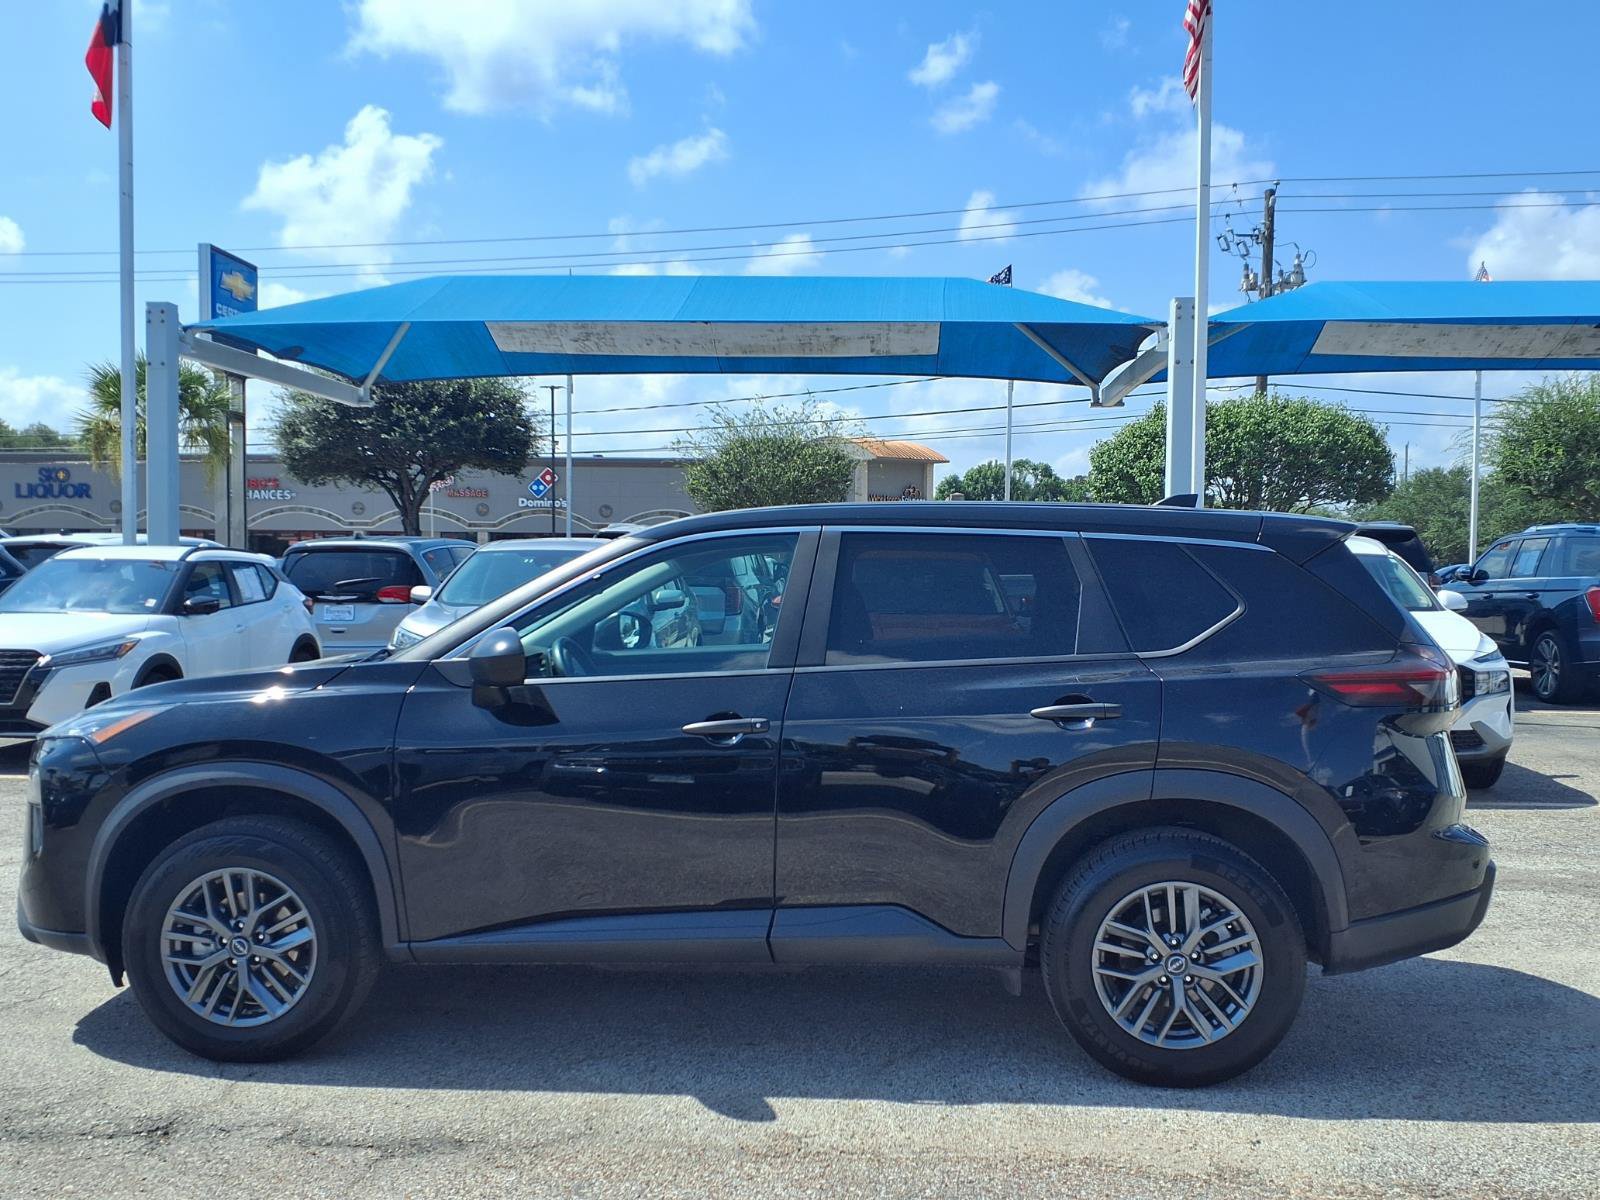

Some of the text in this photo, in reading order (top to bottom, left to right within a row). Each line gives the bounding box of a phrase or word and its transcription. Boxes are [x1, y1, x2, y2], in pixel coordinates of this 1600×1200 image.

[15, 483, 92, 499] LIQUOR
[447, 488, 488, 498] MASSAGE
[518, 497, 568, 508] Domino's
